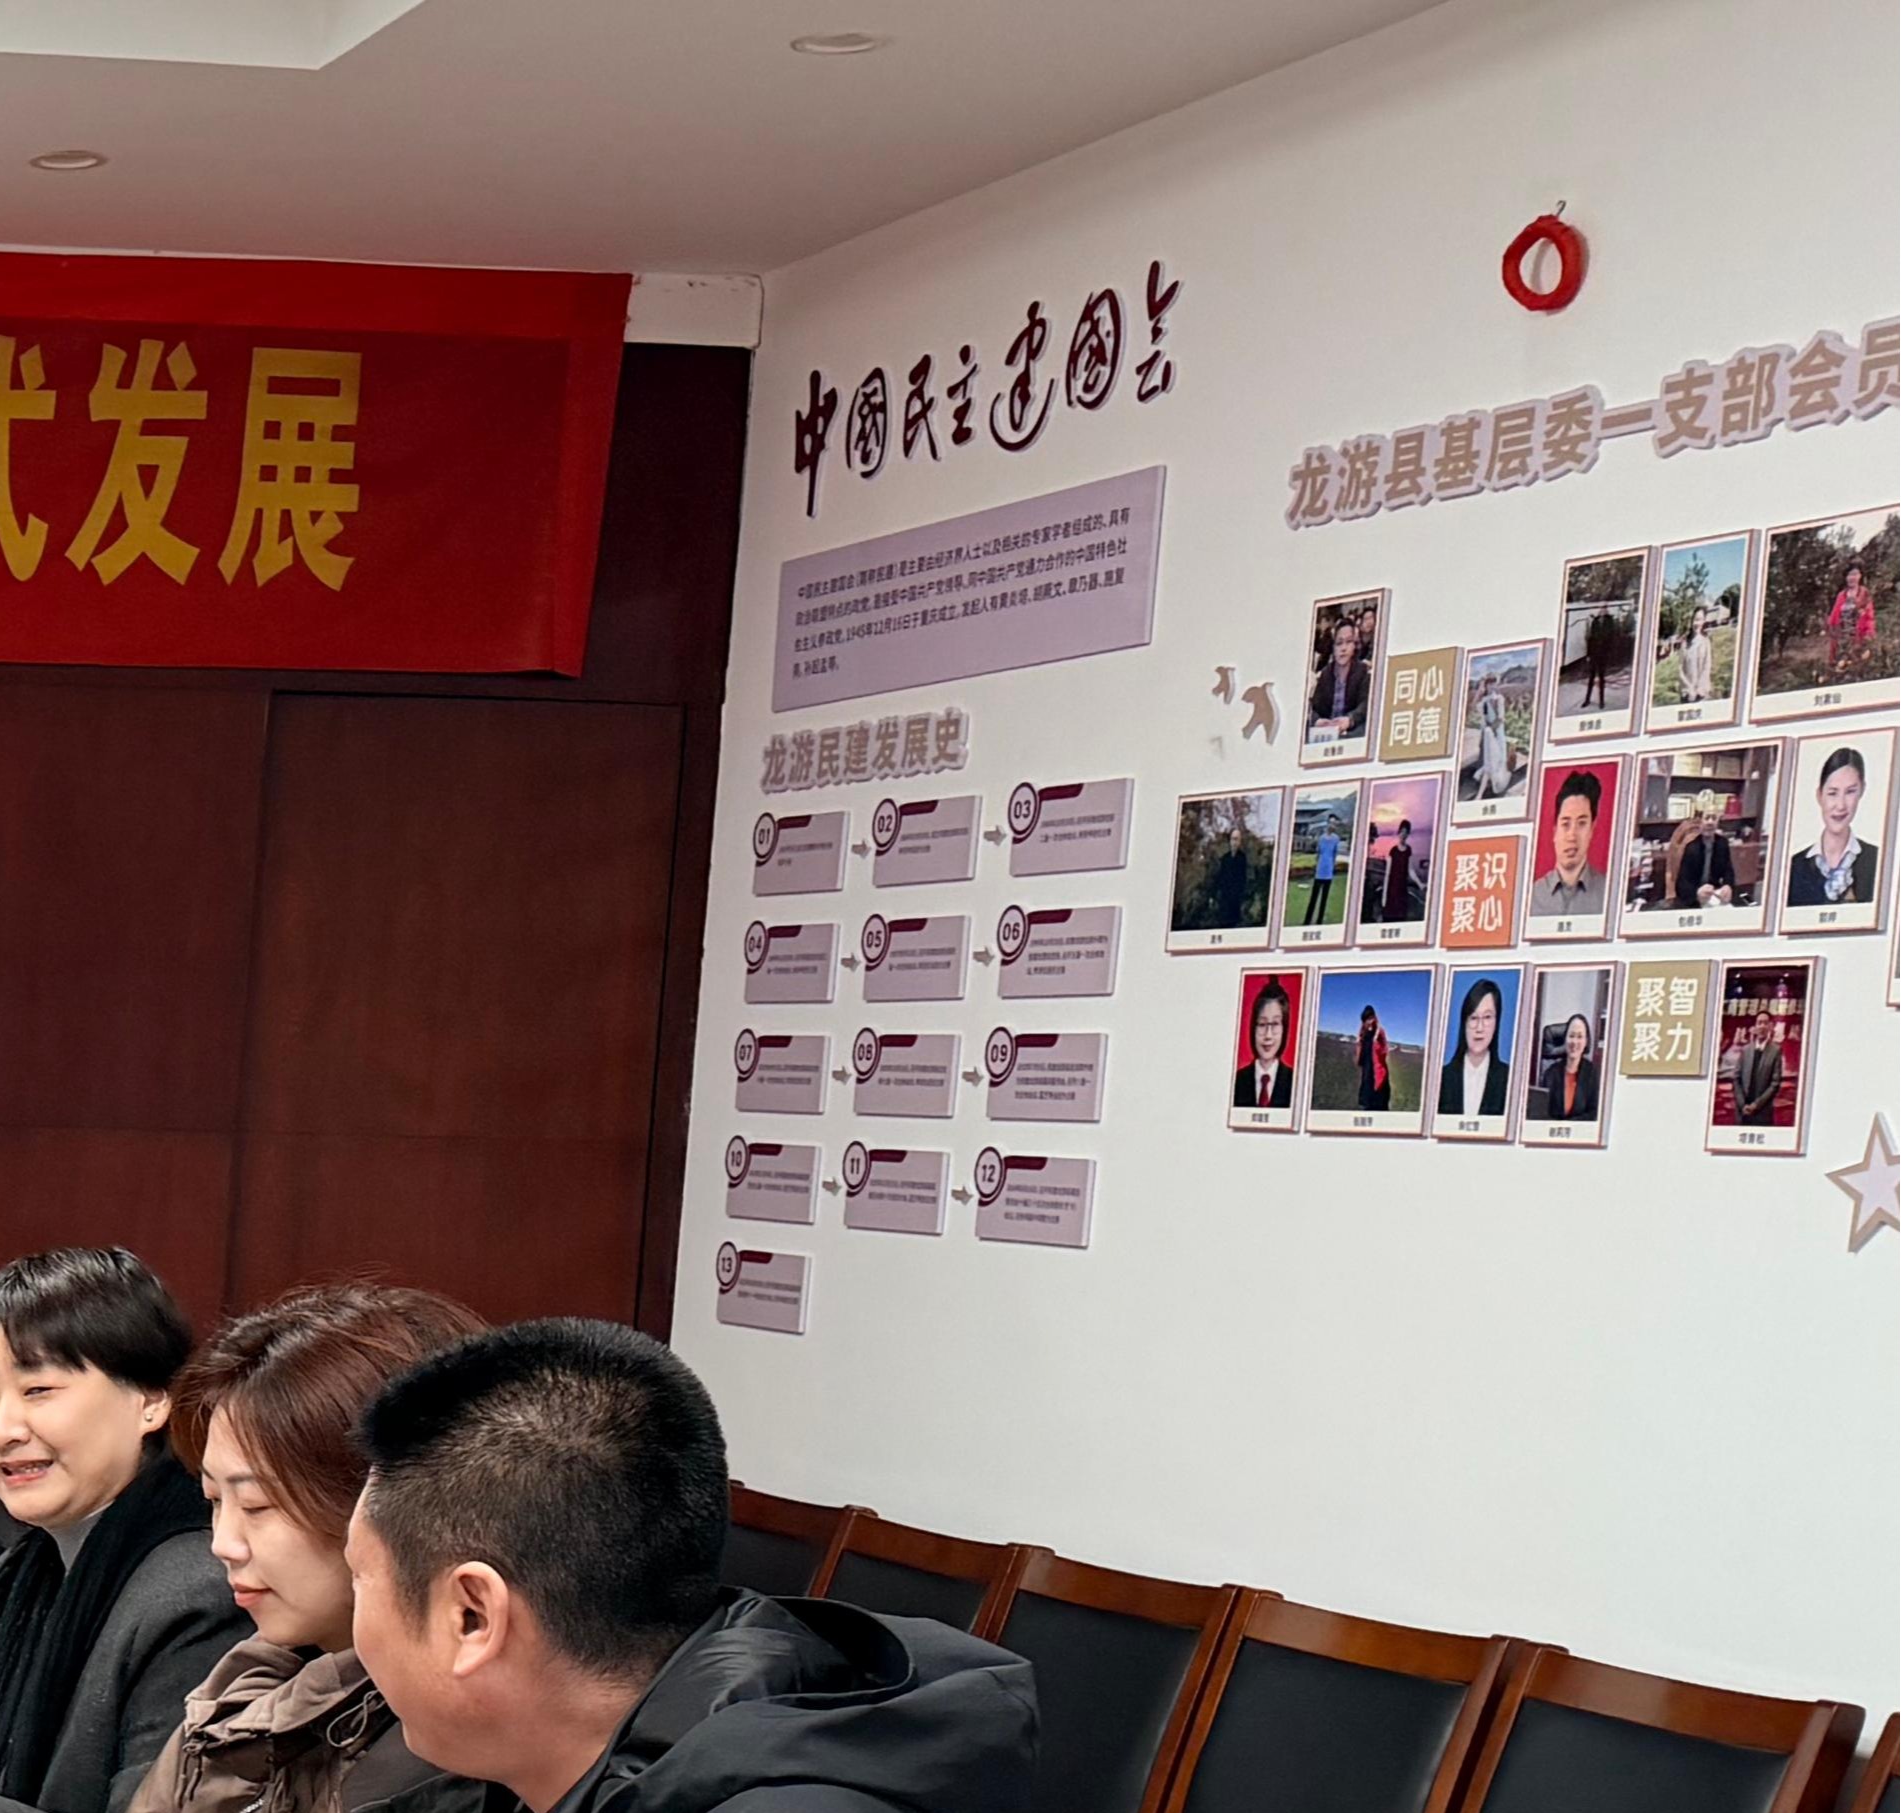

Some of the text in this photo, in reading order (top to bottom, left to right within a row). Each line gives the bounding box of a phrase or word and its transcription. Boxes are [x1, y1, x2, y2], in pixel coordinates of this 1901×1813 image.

[1393, 665, 1443, 705] 同心
[1388, 707, 1441, 747] 同德
[761, 707, 965, 789] 龙游民建发展史
[1013, 800, 1031, 819] 03
[877, 815, 893, 833] 02
[758, 830, 771, 845] 01
[1455, 852, 1508, 892] 聚识
[1450, 895, 1503, 934] 聚心
[866, 931, 882, 948] 05
[1002, 922, 1020, 941] 06
[748, 936, 762, 951] 04
[1635, 976, 1699, 1017] 聚智
[1631, 1021, 1693, 1062] 聚力
[739, 1045, 752, 1061] 07
[858, 1044, 873, 1061] 08
[990, 1044, 1008, 1062] 09
[731, 1151, 742, 1167] 10
[849, 1157, 861, 1174] 11
[981, 1164, 996, 1183] 12
[721, 1257, 733, 1273] 13
